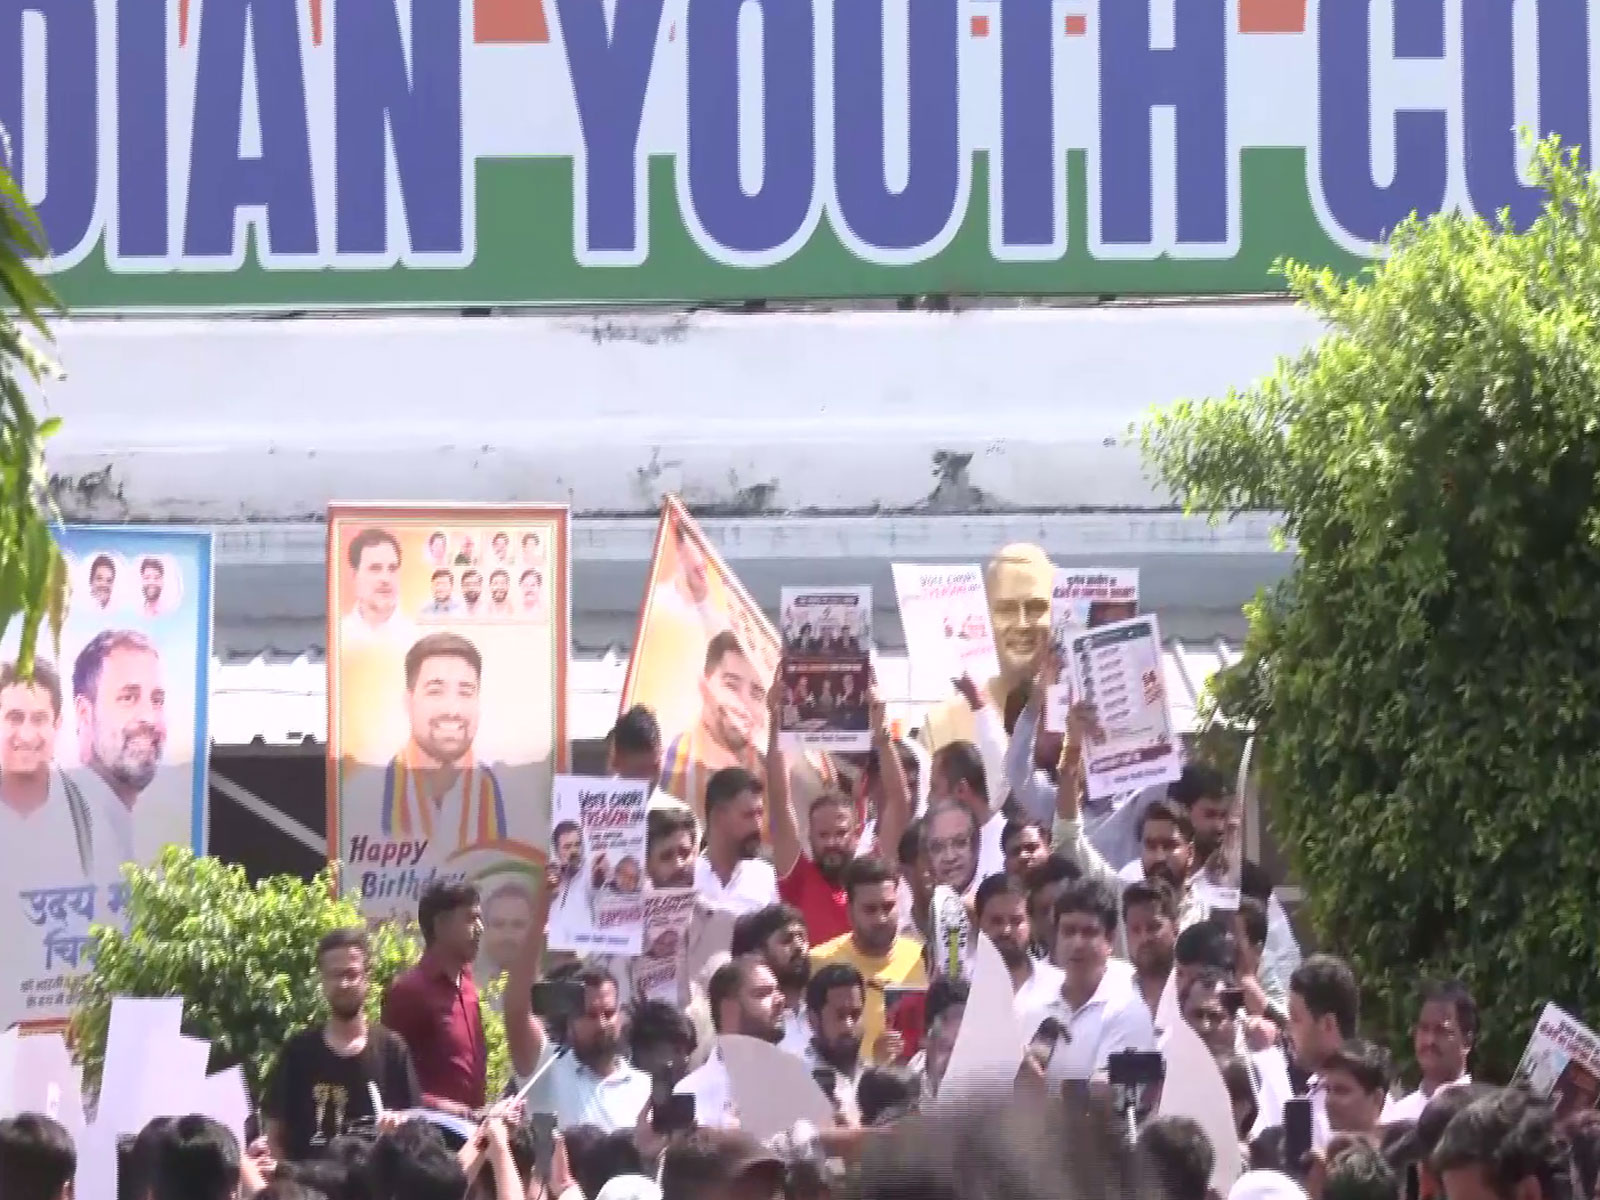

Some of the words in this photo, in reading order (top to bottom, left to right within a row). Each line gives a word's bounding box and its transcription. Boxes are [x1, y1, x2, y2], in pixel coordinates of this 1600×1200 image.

[550, 0, 1240, 268] YOUTH
[348, 834, 429, 867] Happy
[361, 866, 467, 901] Birthd
[19, 884, 97, 926] उदय
